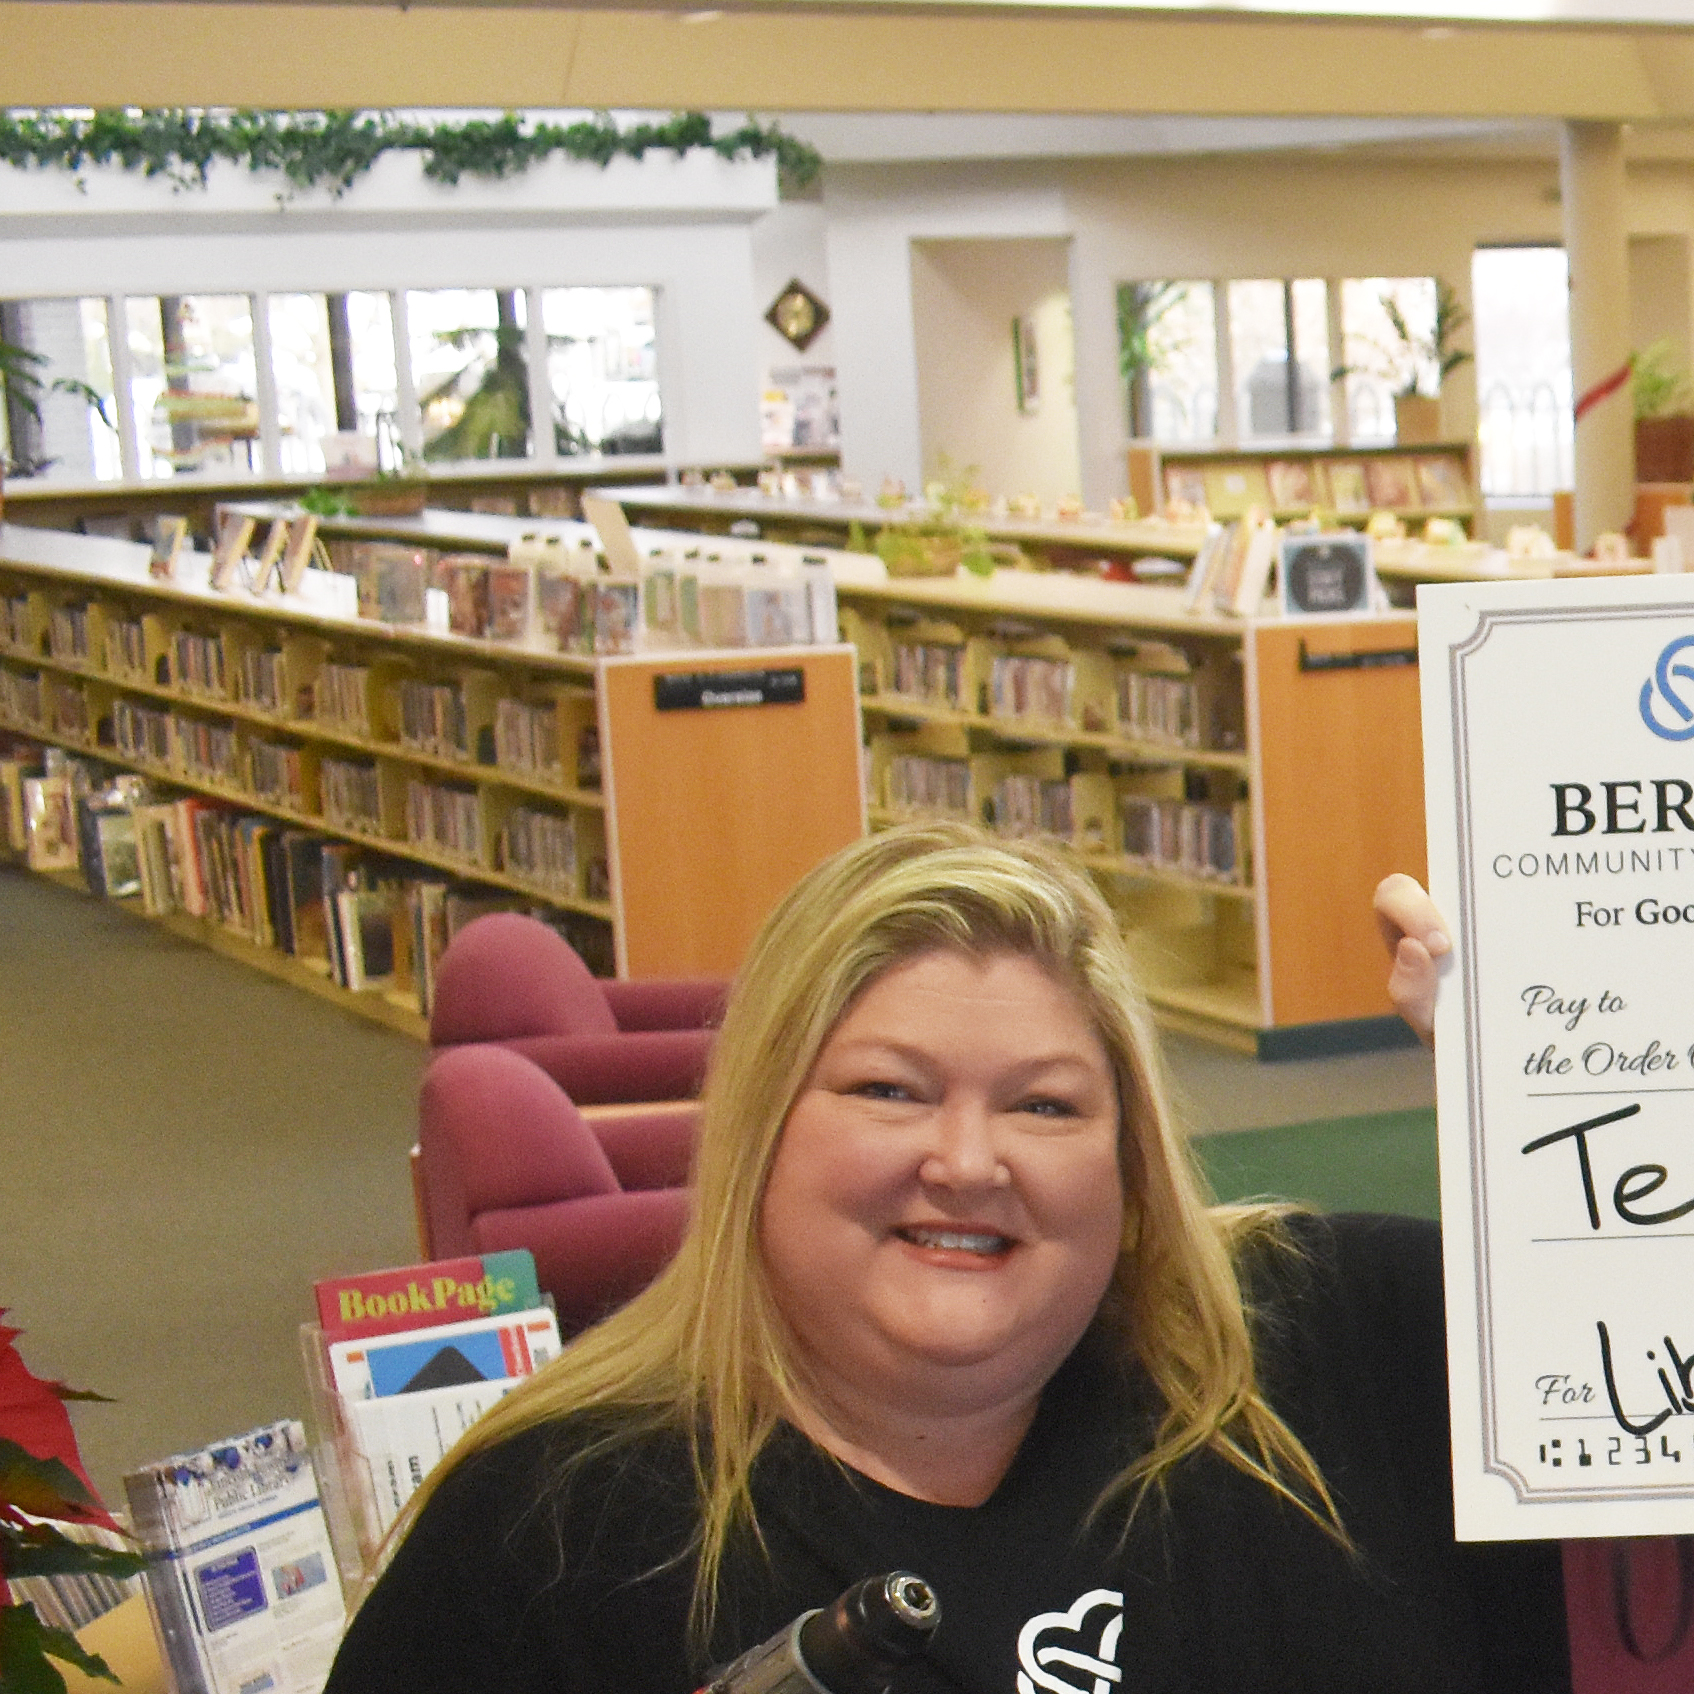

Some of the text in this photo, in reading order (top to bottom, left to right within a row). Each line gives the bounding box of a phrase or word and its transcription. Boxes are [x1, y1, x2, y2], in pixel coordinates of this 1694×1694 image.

[1575, 900, 1625, 927] For
[1521, 984, 1628, 1019] Pay to
[1522, 1046, 1574, 1077] the
[1580, 1041, 1681, 1077] Order
[338, 1275, 516, 1322] BookPage
[1534, 1373, 1597, 1406] For
